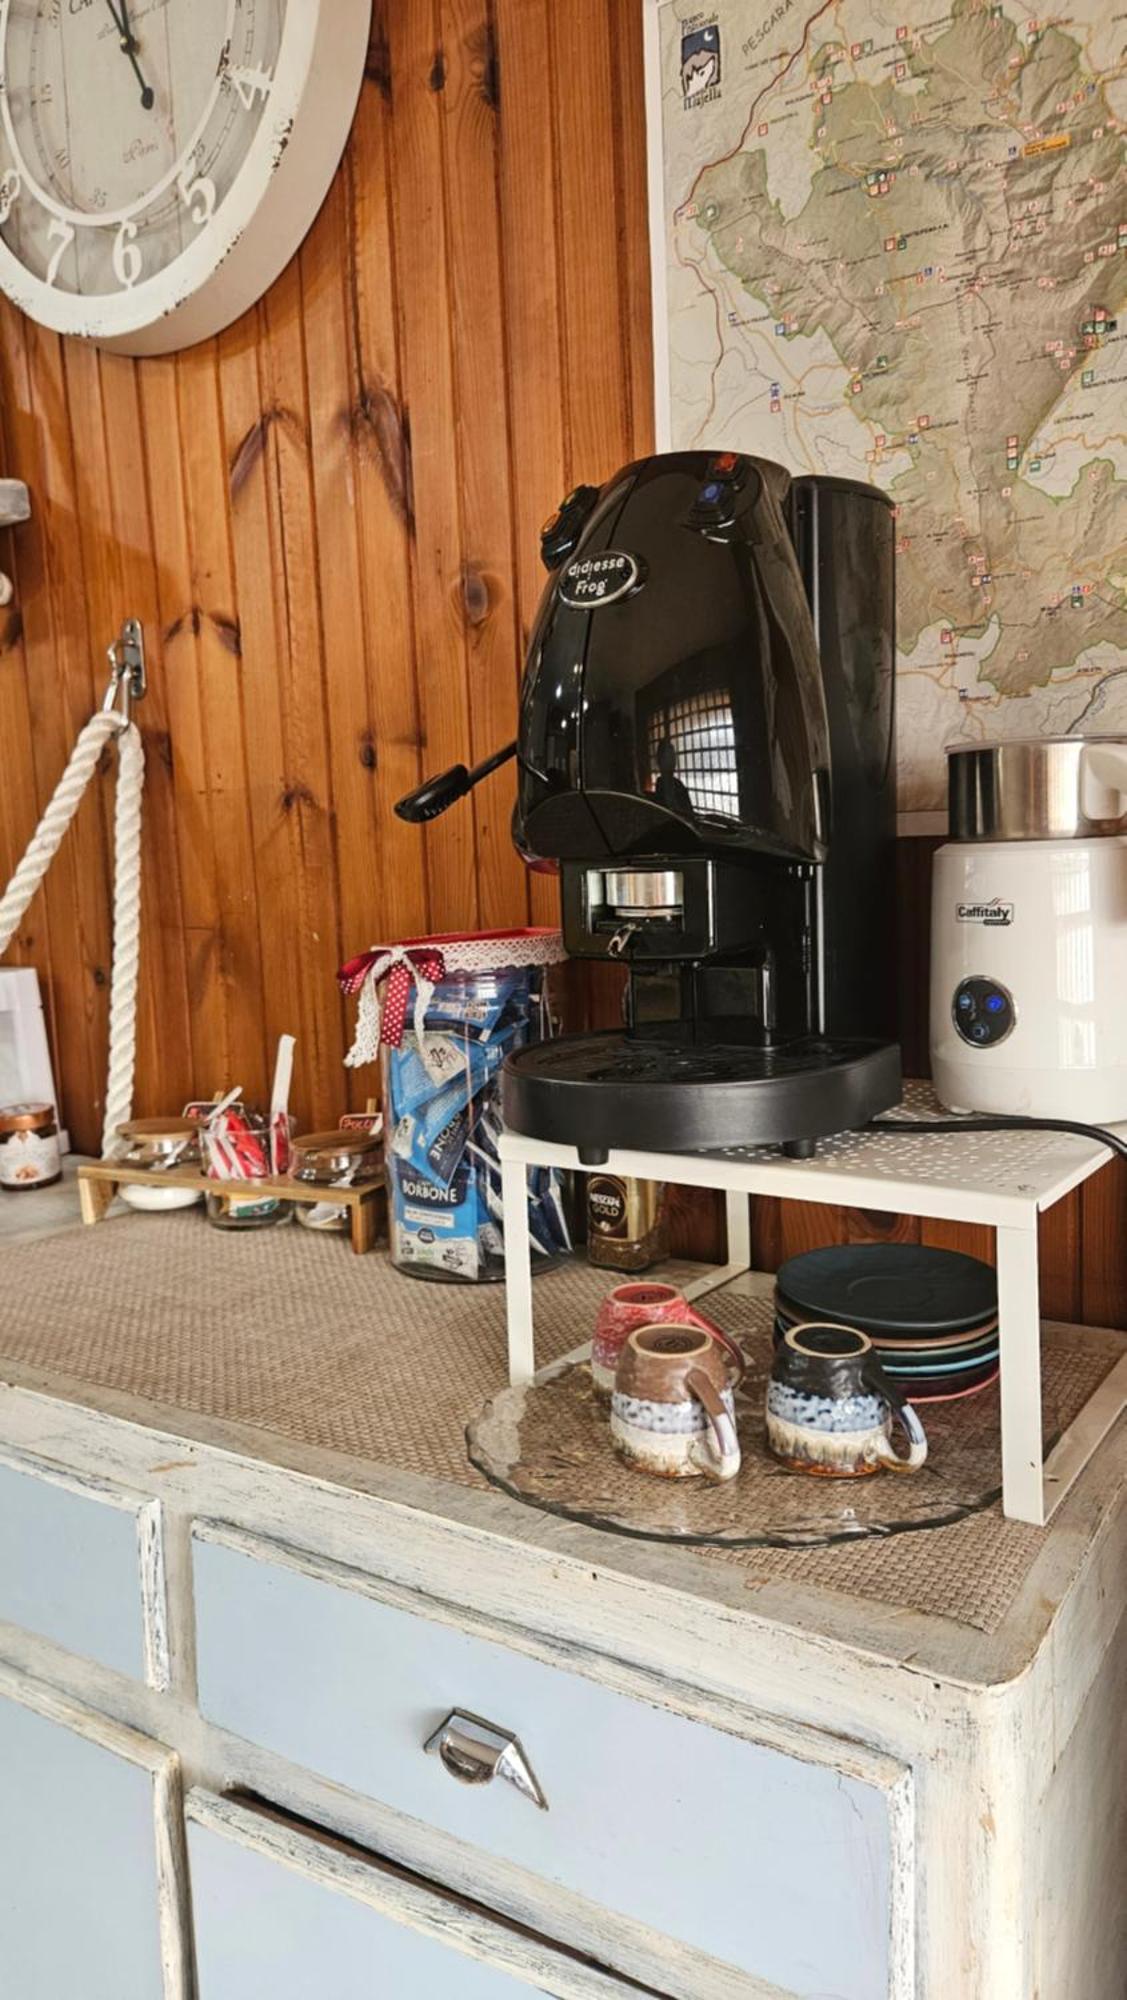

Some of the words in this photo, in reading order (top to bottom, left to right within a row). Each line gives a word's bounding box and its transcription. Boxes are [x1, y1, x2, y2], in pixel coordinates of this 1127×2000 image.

[741, 0, 793, 55] PESCARA
[228, 61, 274, 110] 4
[177, 158, 217, 224] 5
[46, 219, 76, 287] 7
[112, 219, 142, 286] 6
[568, 557, 625, 580] didiesse
[575, 579, 606, 596] Frog
[957, 906, 1010, 920] Caffitaly
[402, 1179, 458, 1203] BORBONE
[592, 1203, 620, 1217] GOLD
